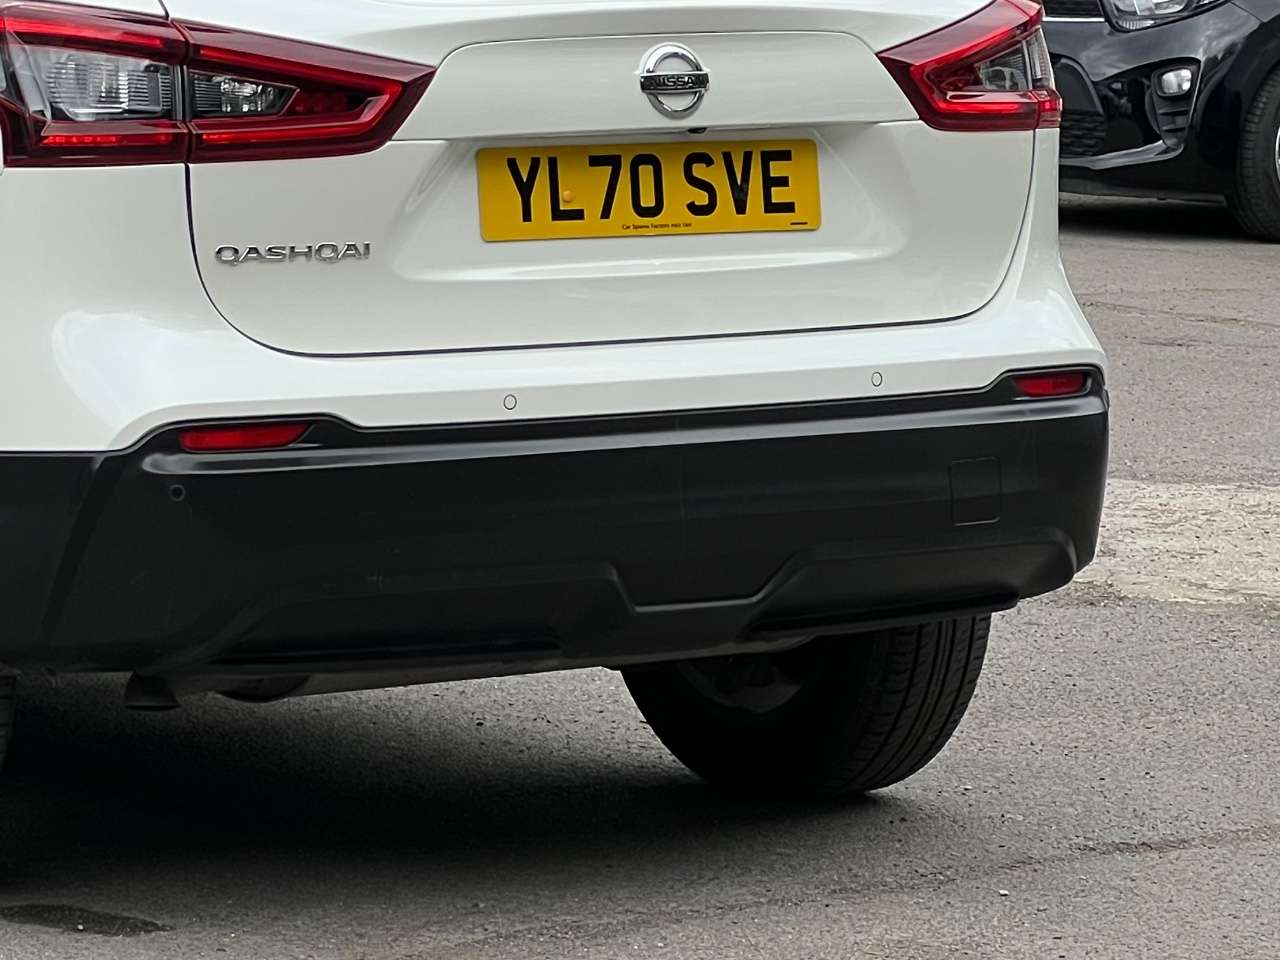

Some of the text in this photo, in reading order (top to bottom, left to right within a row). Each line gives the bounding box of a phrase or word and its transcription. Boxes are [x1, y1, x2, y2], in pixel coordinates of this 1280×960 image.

[507, 150, 796, 222] YL70 SVE
[216, 241, 371, 265] QASHQAI
